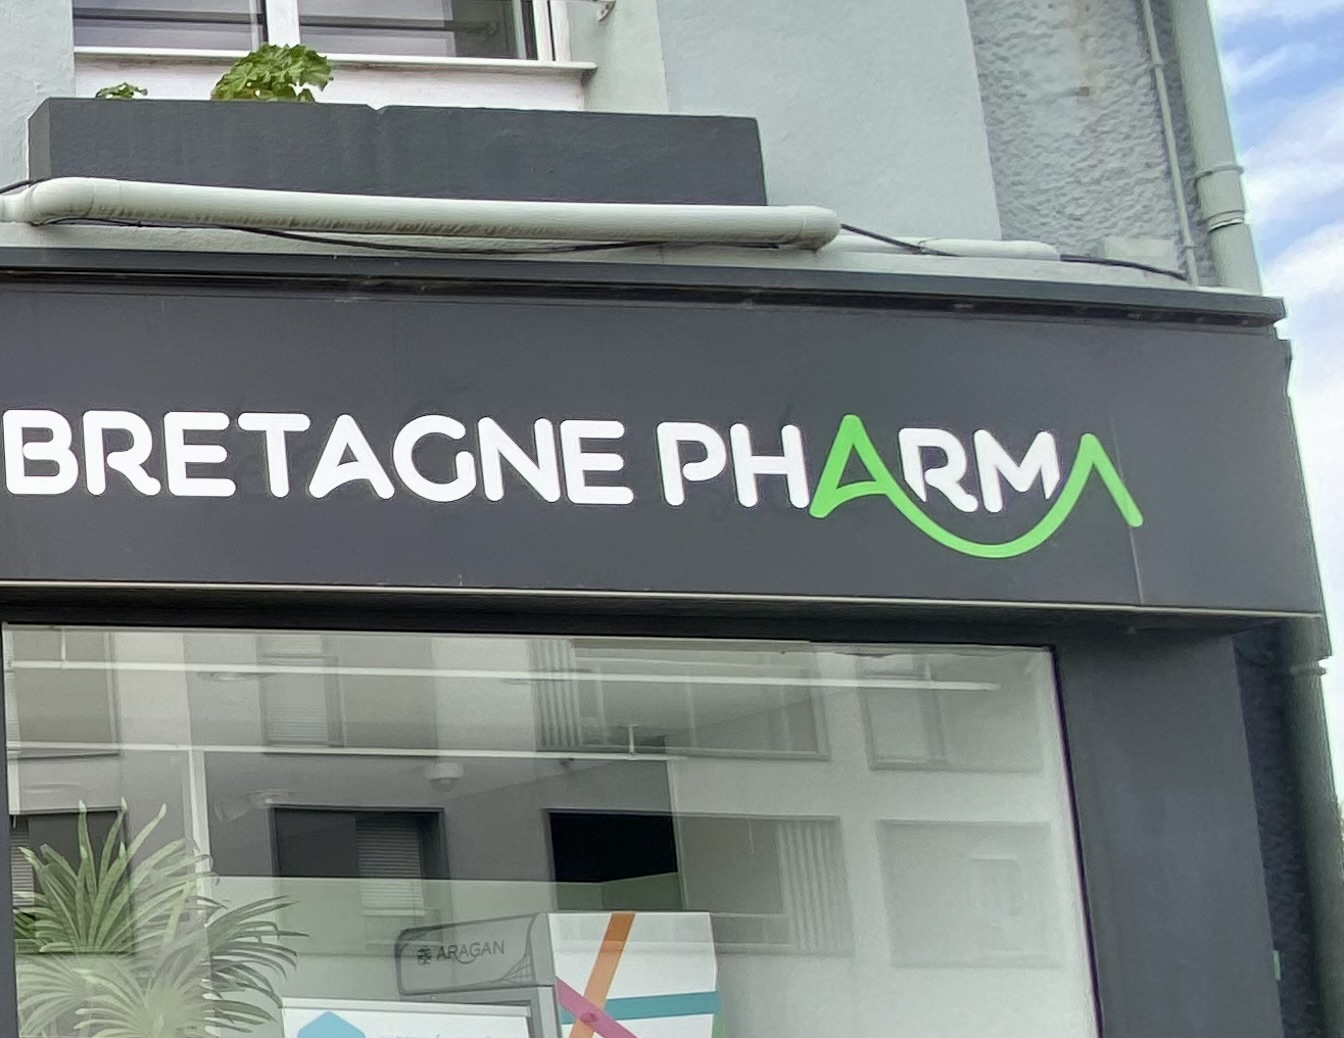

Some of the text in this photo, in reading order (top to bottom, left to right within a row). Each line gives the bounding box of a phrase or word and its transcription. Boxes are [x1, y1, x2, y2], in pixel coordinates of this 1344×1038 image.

[1, 408, 1144, 558] BRETAGNE PHARMA
[436, 940, 505, 964] ARAGAN
